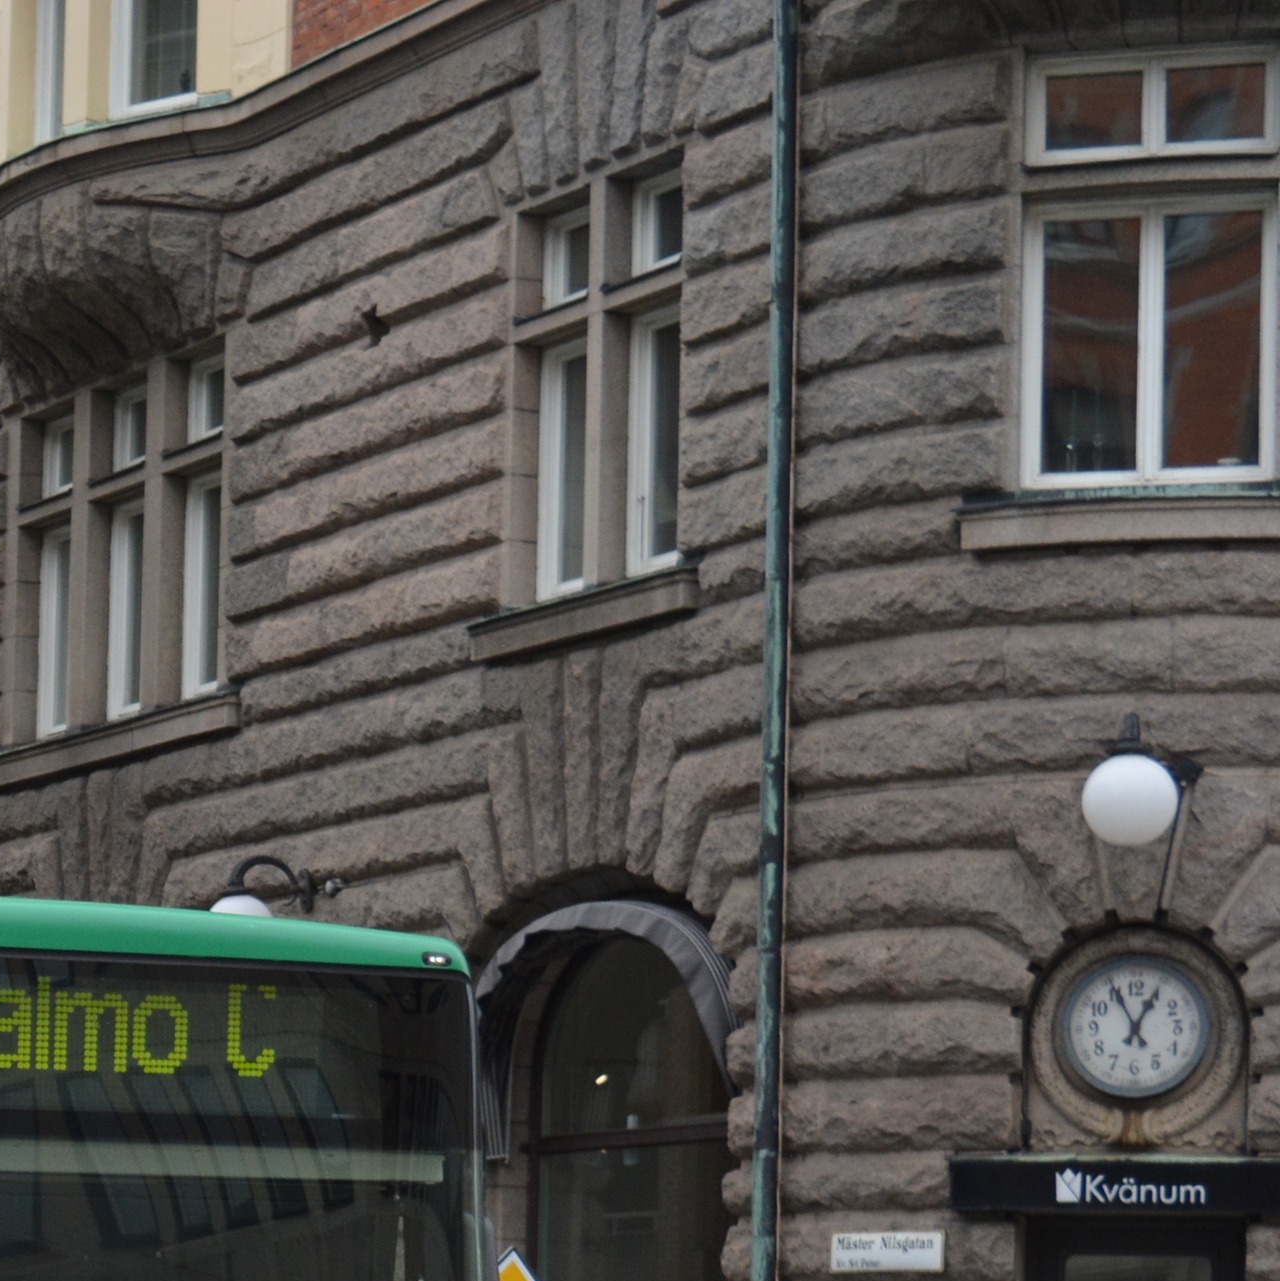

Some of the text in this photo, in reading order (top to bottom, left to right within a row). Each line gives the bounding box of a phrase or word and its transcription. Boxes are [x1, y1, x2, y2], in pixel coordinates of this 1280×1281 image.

[1127, 979, 1145, 997] 12
[1091, 1000, 1108, 1017] 10
[1088, 1020, 1099, 1036] 9
[1094, 1039, 1105, 1057] 8
[1108, 1053, 1119, 1071] 7
[1129, 1058, 1140, 1076] 6
[1085, 1174, 1207, 1204] Kvänum
[836, 1234, 934, 1254] Mäster Nilsgatan
